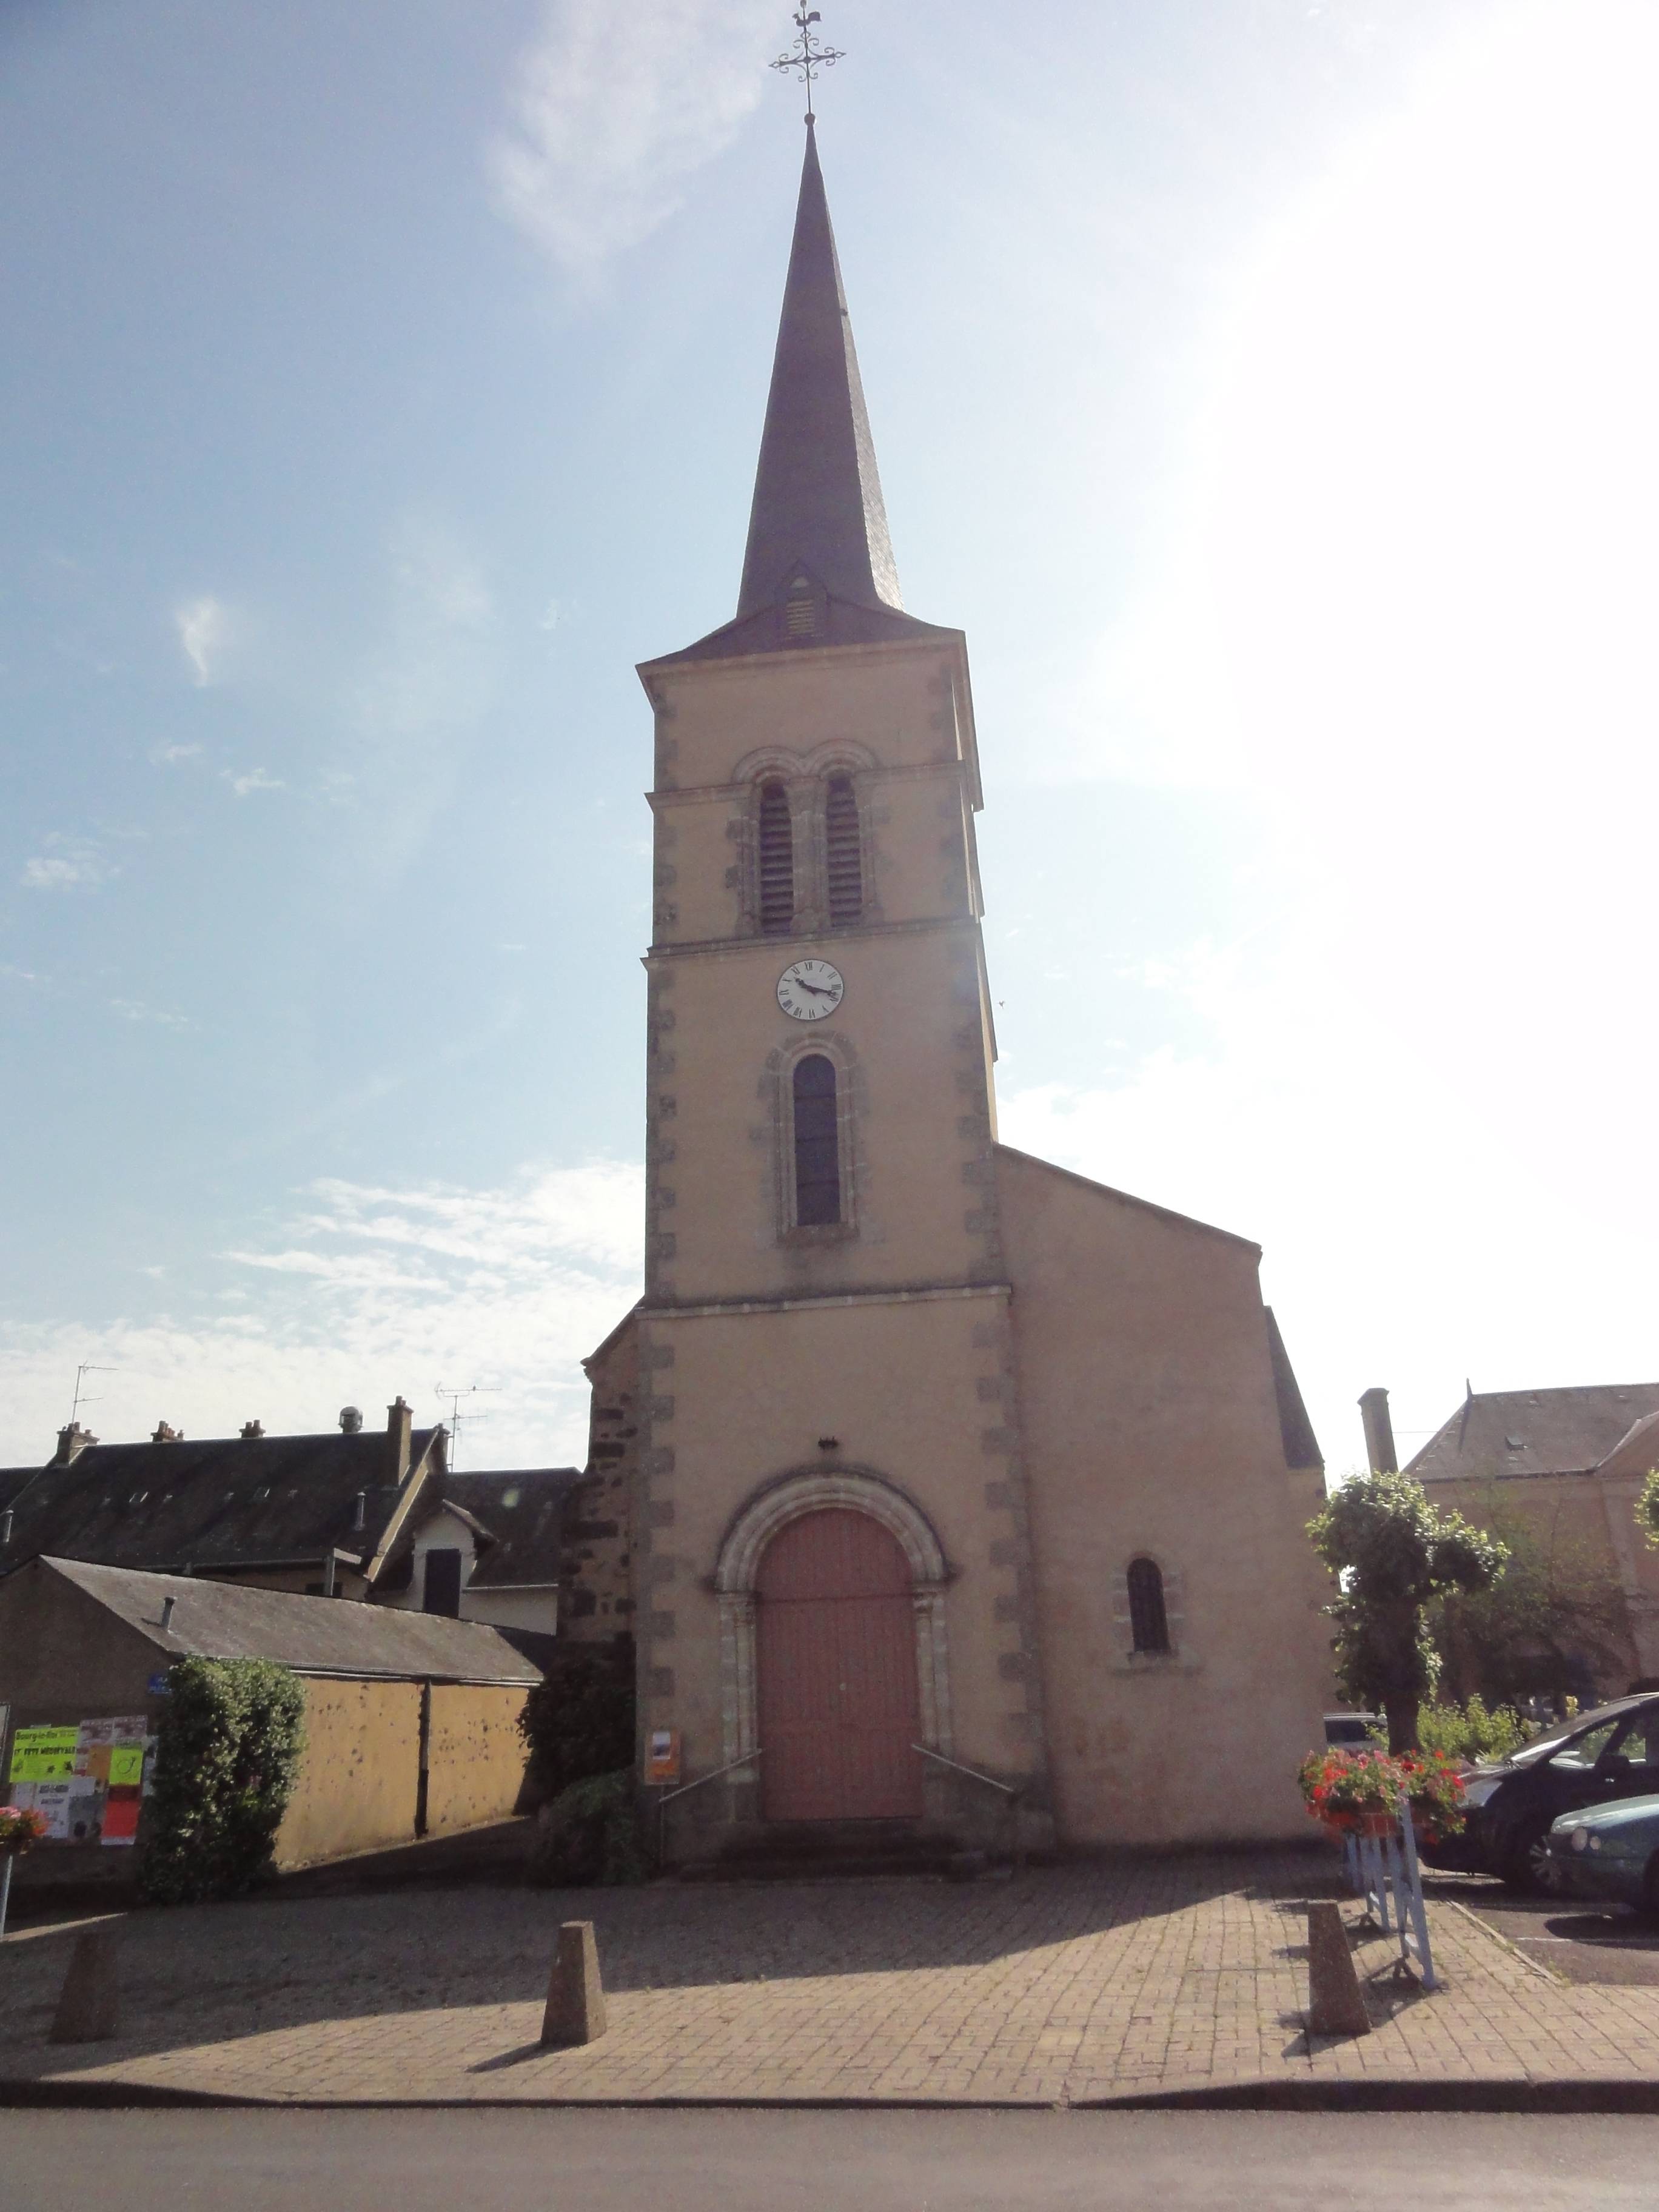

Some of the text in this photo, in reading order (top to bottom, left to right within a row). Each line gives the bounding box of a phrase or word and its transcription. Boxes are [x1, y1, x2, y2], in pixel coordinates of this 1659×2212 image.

[791, 966, 800, 975] XI
[804, 961, 813, 971] XII
[827, 971, 837, 980] II
[809, 1009, 816, 1019] VI
